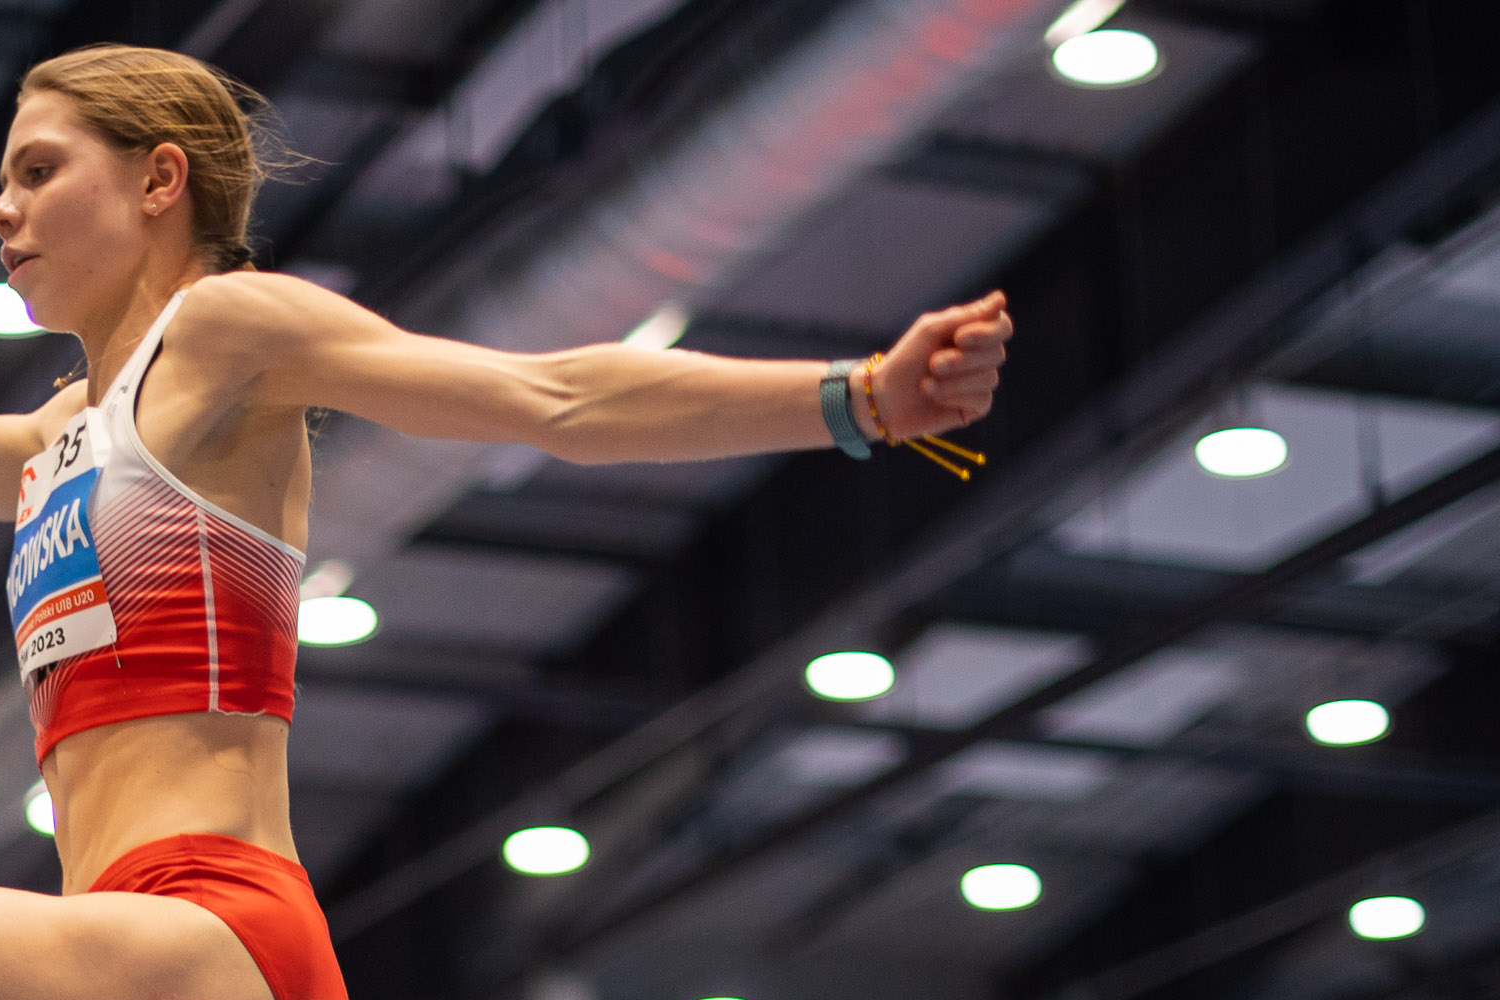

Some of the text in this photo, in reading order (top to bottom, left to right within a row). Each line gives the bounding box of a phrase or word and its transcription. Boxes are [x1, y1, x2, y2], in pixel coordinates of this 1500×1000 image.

[55, 597, 73, 614] U18
[73, 588, 95, 607] U20
[31, 626, 66, 657] 2023
